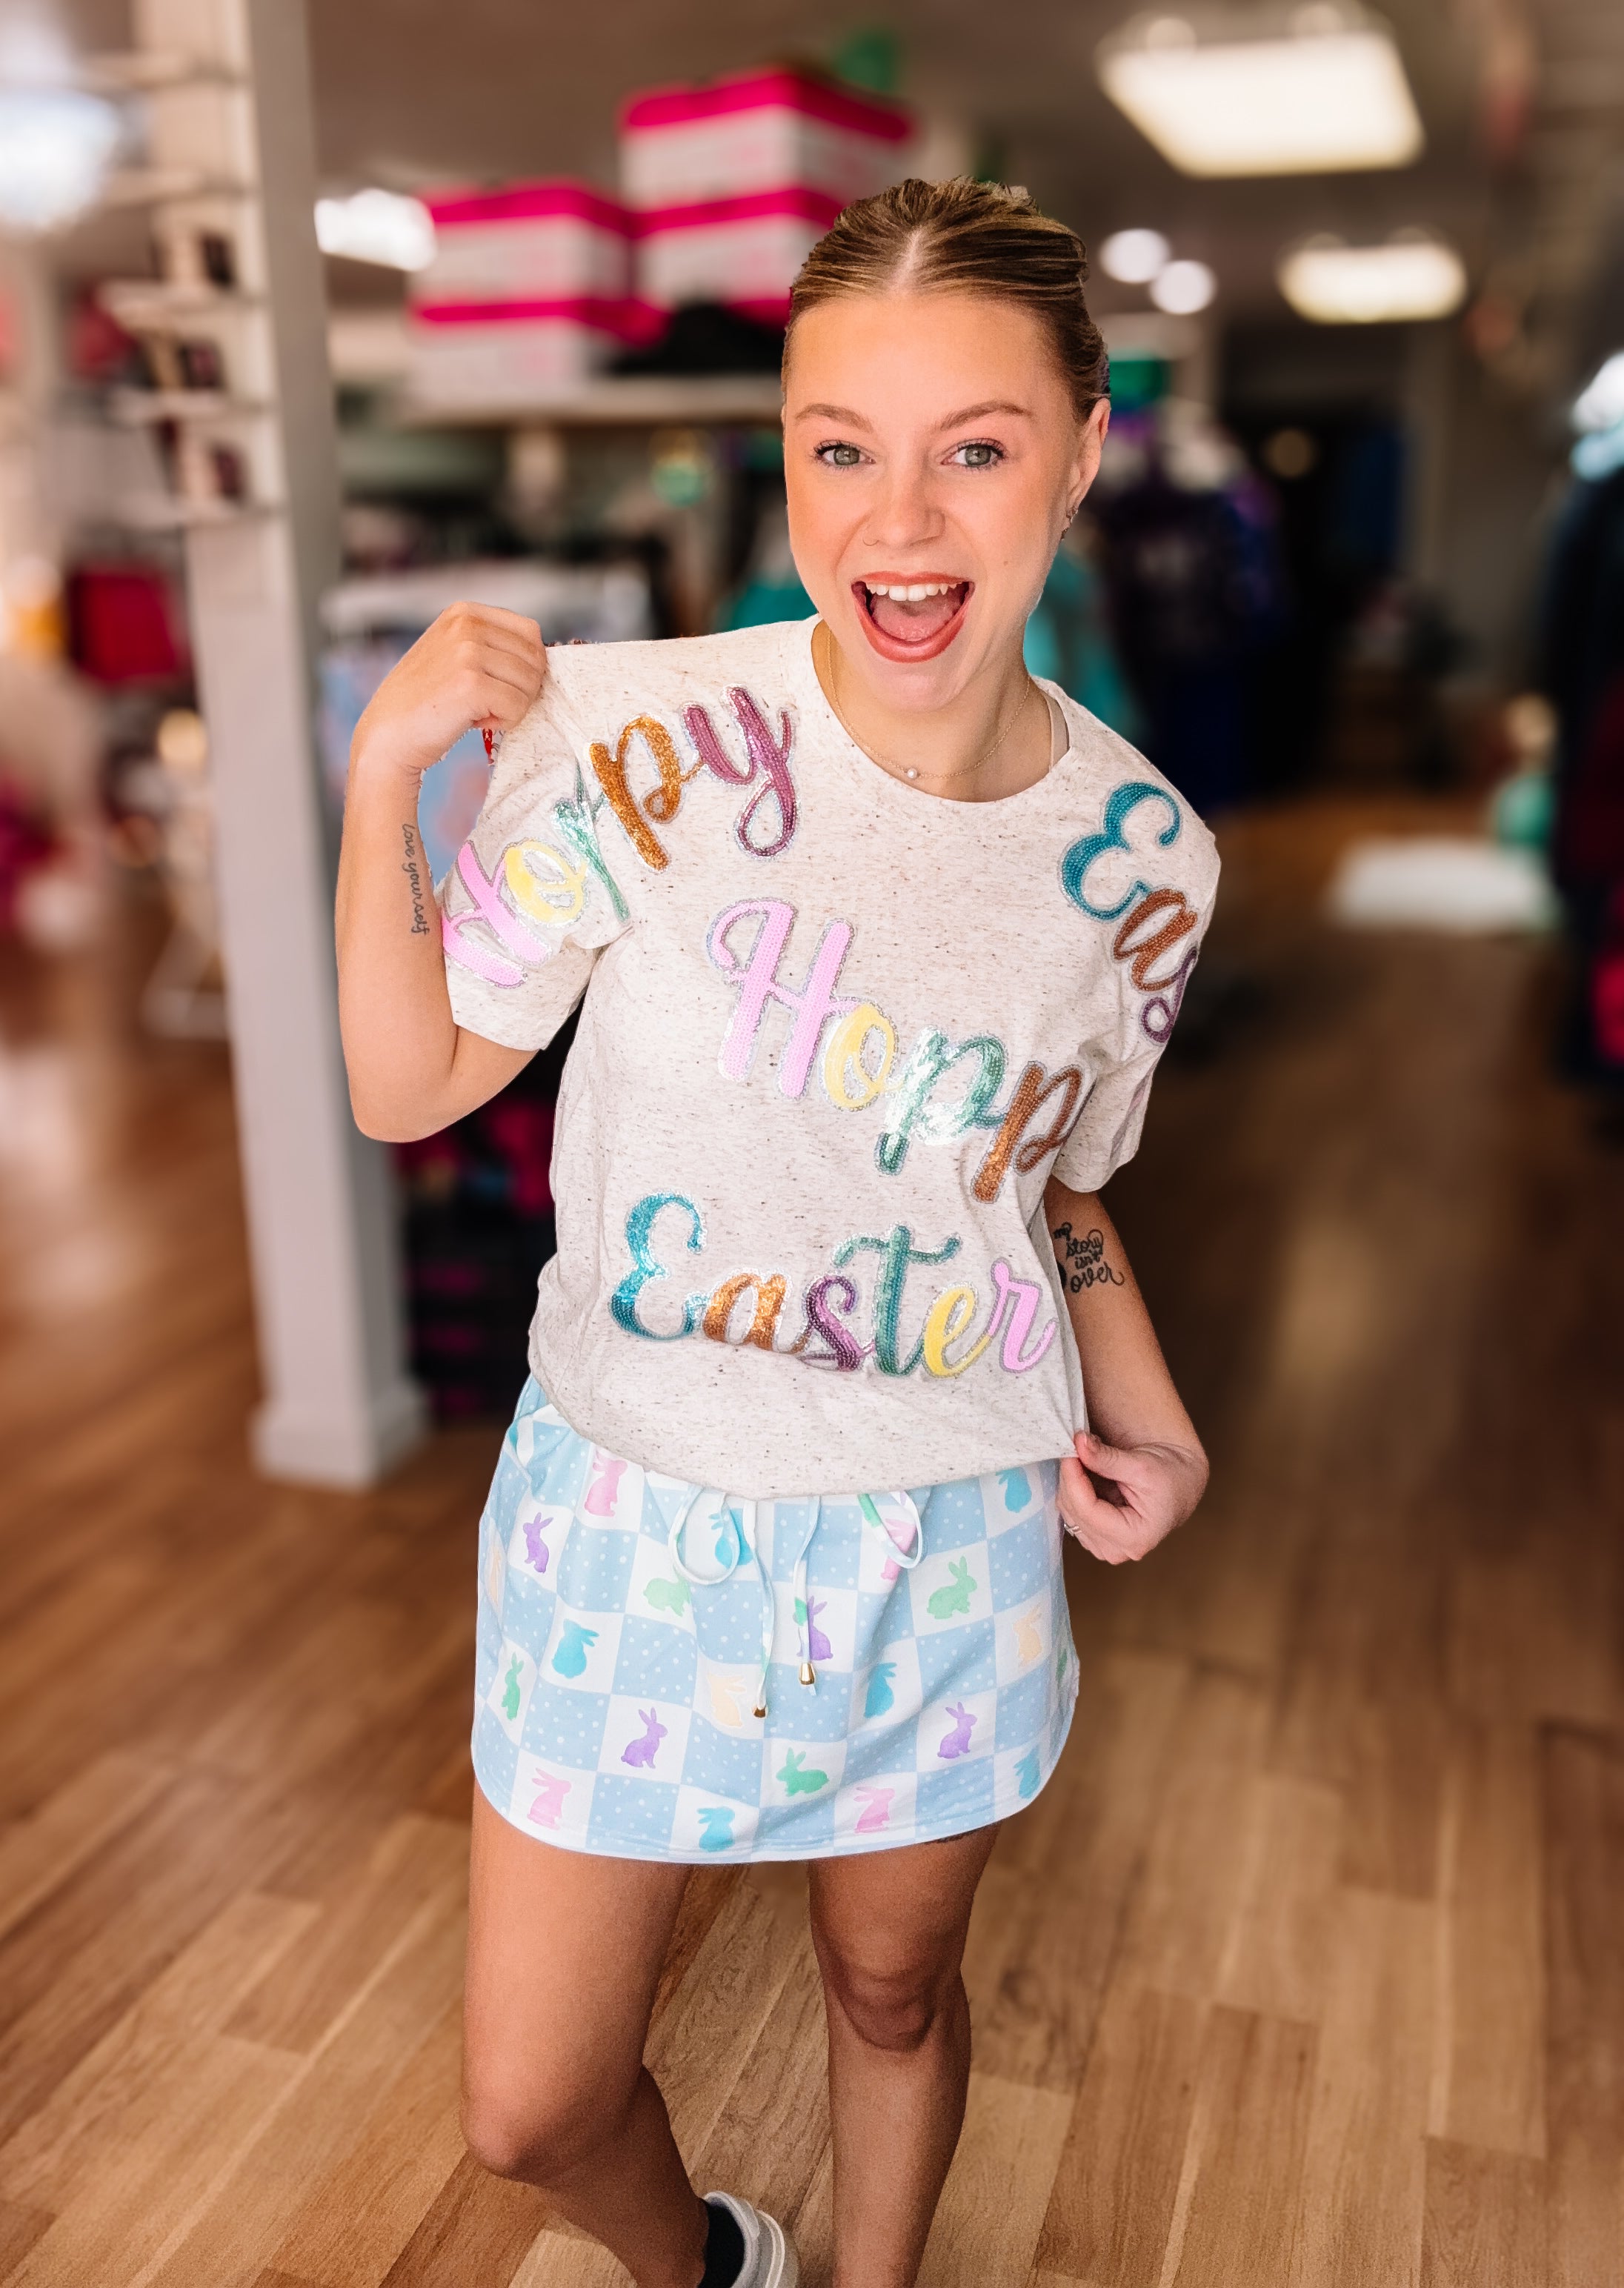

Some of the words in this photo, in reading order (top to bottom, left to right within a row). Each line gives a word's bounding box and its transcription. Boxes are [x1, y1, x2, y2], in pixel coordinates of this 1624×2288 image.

[402, 862, 430, 936] yourself
[706, 897, 1088, 1203] Hopp
[609, 1191, 1058, 1378] Easter
[1070, 1261, 1125, 1293] over
